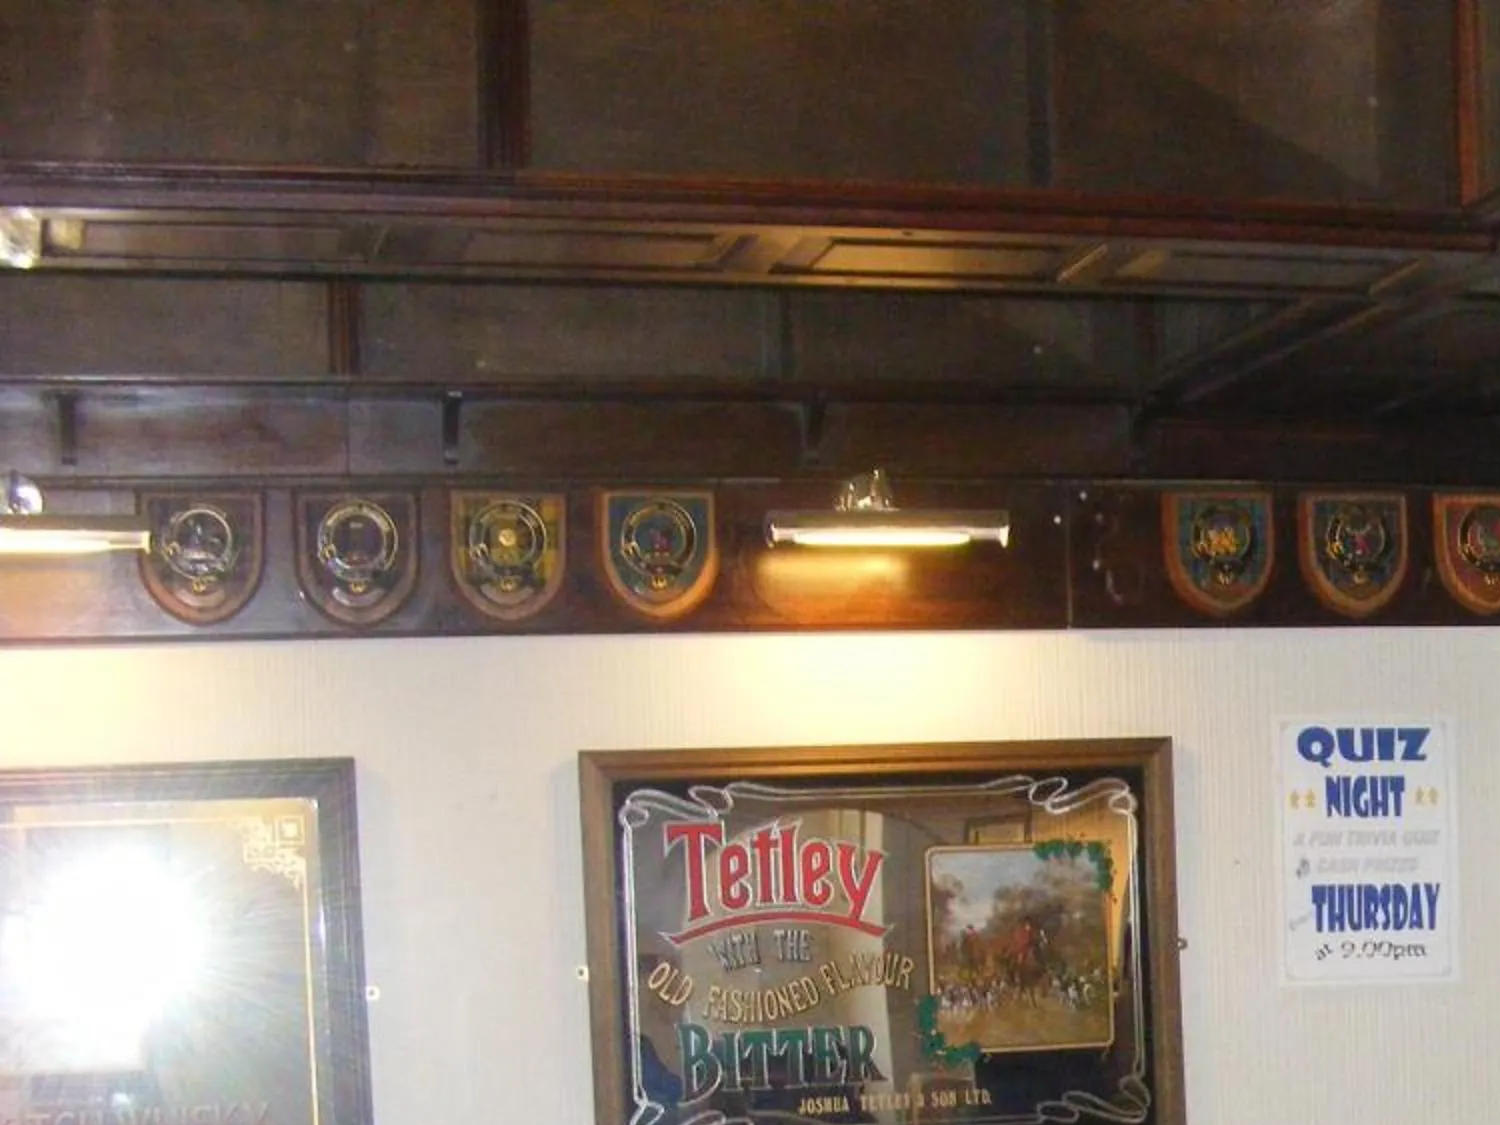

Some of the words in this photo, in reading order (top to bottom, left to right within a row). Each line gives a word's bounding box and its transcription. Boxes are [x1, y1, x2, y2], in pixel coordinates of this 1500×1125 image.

[1296, 726, 1431, 768] QUIZ
[1325, 775, 1405, 818] NIGHT
[664, 817, 888, 930] Tetley
[1311, 882, 1441, 933] THURSDAY
[709, 930, 762, 972] WITH
[773, 928, 813, 963] THE
[1313, 943, 1333, 961] at
[1339, 939, 1427, 961] 9.00pm
[648, 961, 693, 1006] OLD
[702, 976, 820, 1024] FASHIONED
[677, 1022, 888, 1106] BITTER
[797, 1095, 849, 1115] JOSHUA
[931, 1090, 957, 1107] SON
